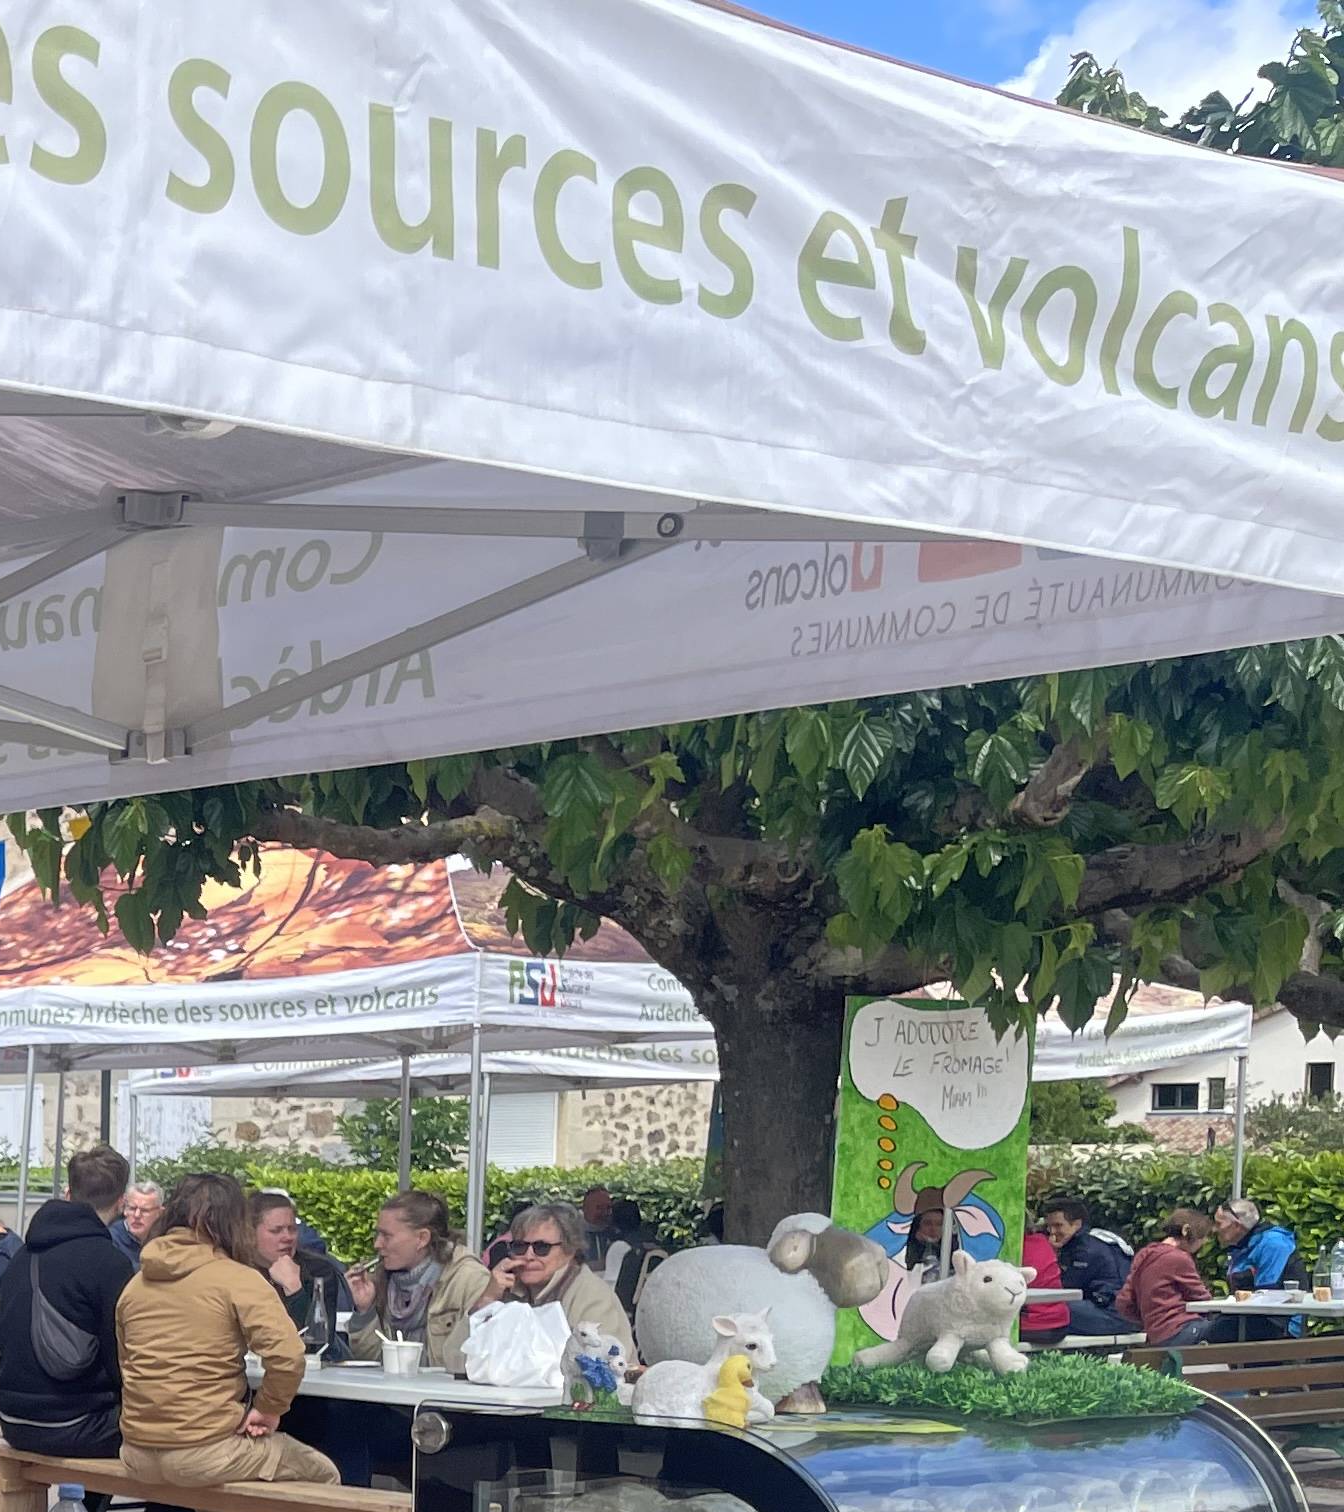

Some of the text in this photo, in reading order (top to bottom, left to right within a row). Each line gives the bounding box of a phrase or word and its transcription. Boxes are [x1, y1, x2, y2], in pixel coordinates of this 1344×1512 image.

[165, 57, 758, 320] sources
[797, 196, 928, 357] et
[79, 1000, 169, 1025] Ardèche
[174, 1000, 213, 1024] des
[218, 997, 308, 1022] sources
[314, 993, 338, 1016] et
[343, 984, 440, 1014] volcans
[892, 1056, 914, 1077] LE
